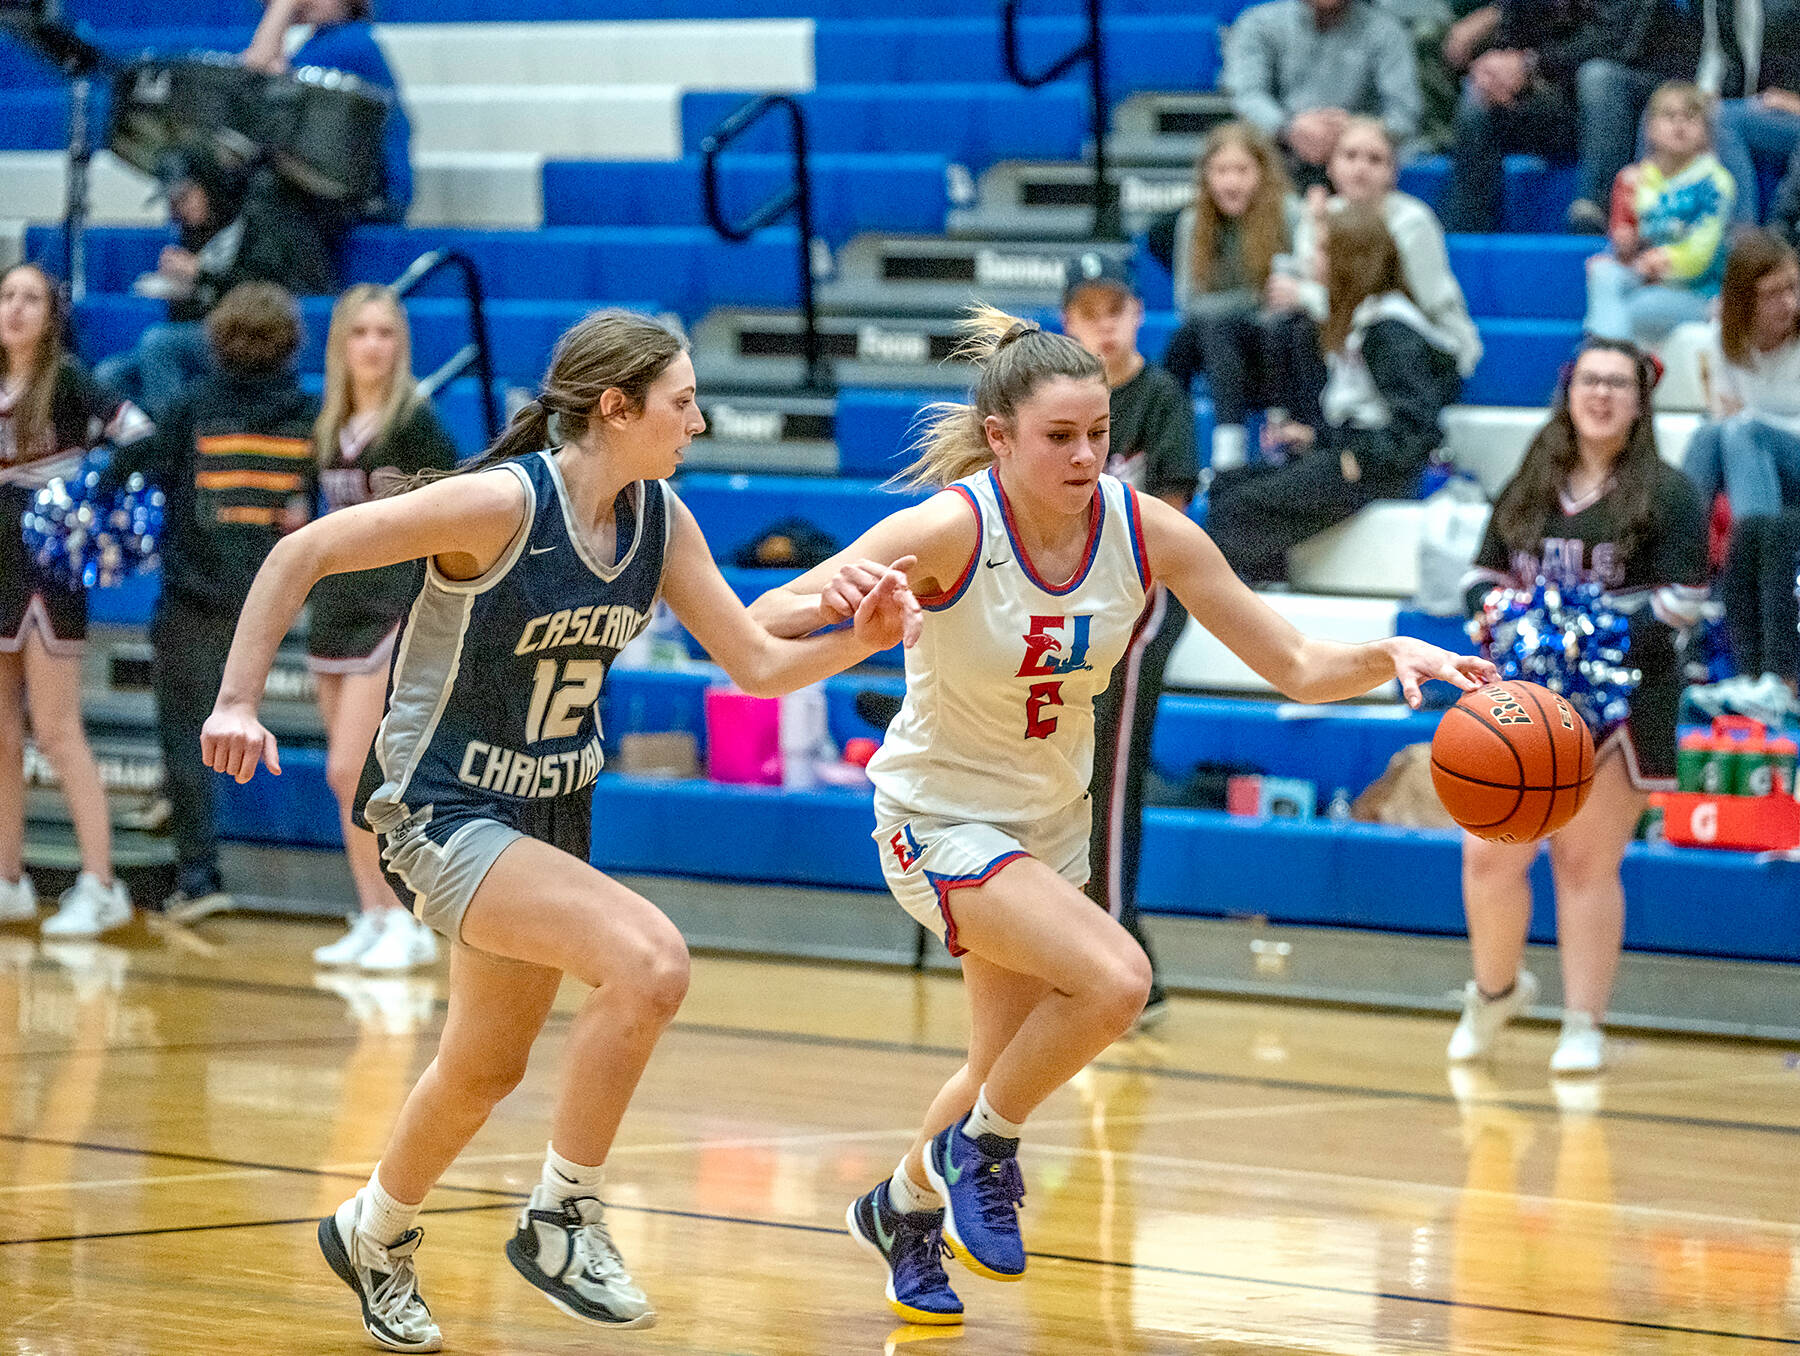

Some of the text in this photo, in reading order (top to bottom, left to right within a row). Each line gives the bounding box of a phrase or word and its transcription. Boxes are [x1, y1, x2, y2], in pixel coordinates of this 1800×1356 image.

[525, 658, 605, 746] 12
[1024, 681, 1064, 740] 2
[1690, 802, 1718, 843] G
